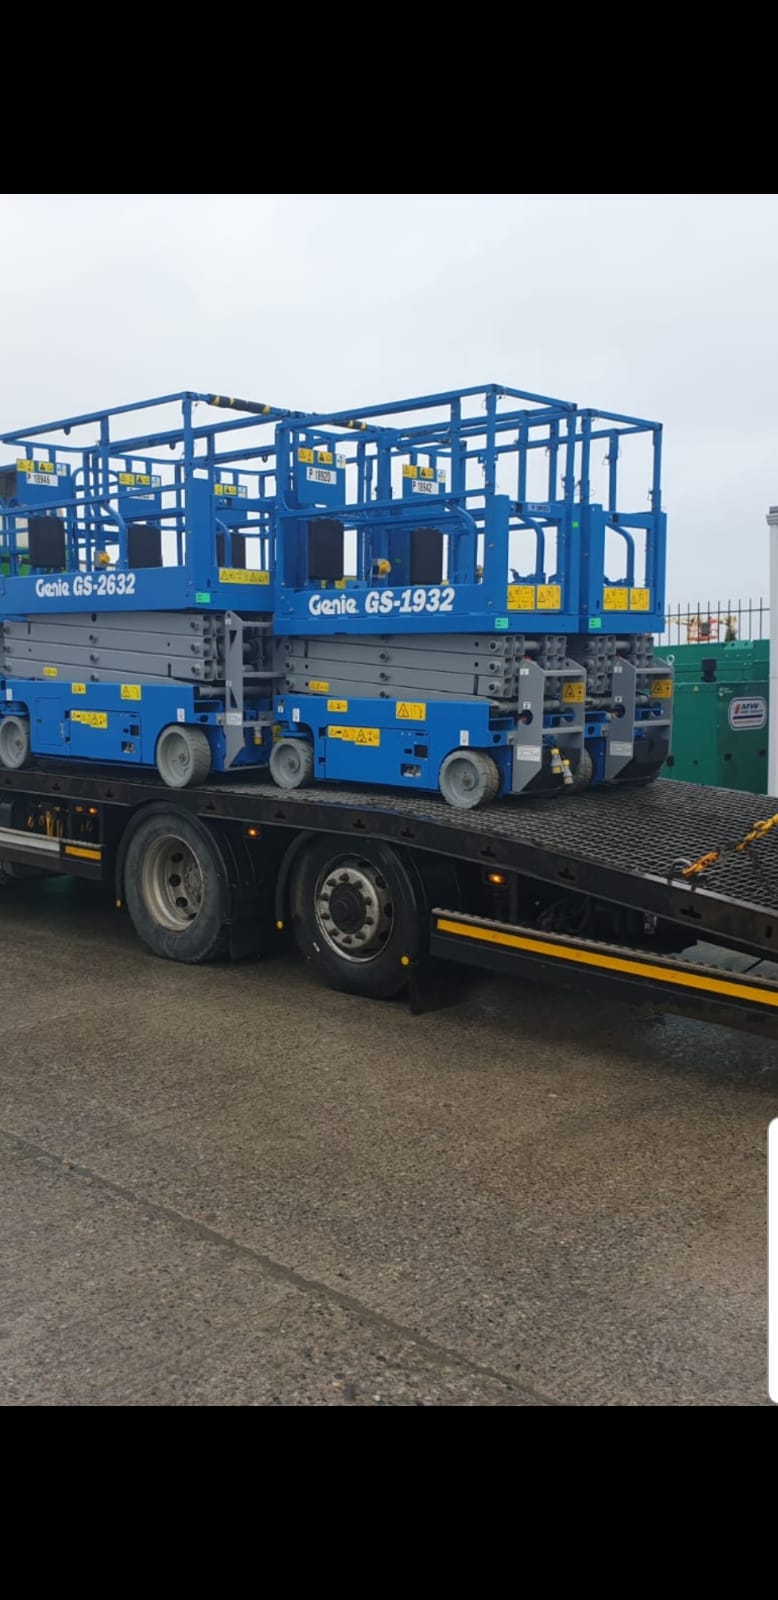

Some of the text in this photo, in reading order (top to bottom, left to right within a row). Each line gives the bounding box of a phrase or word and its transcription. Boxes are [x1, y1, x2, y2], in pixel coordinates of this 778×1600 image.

[36, 572, 136, 598] Genie GS-2632
[308, 587, 456, 616] Genie GS-1932
